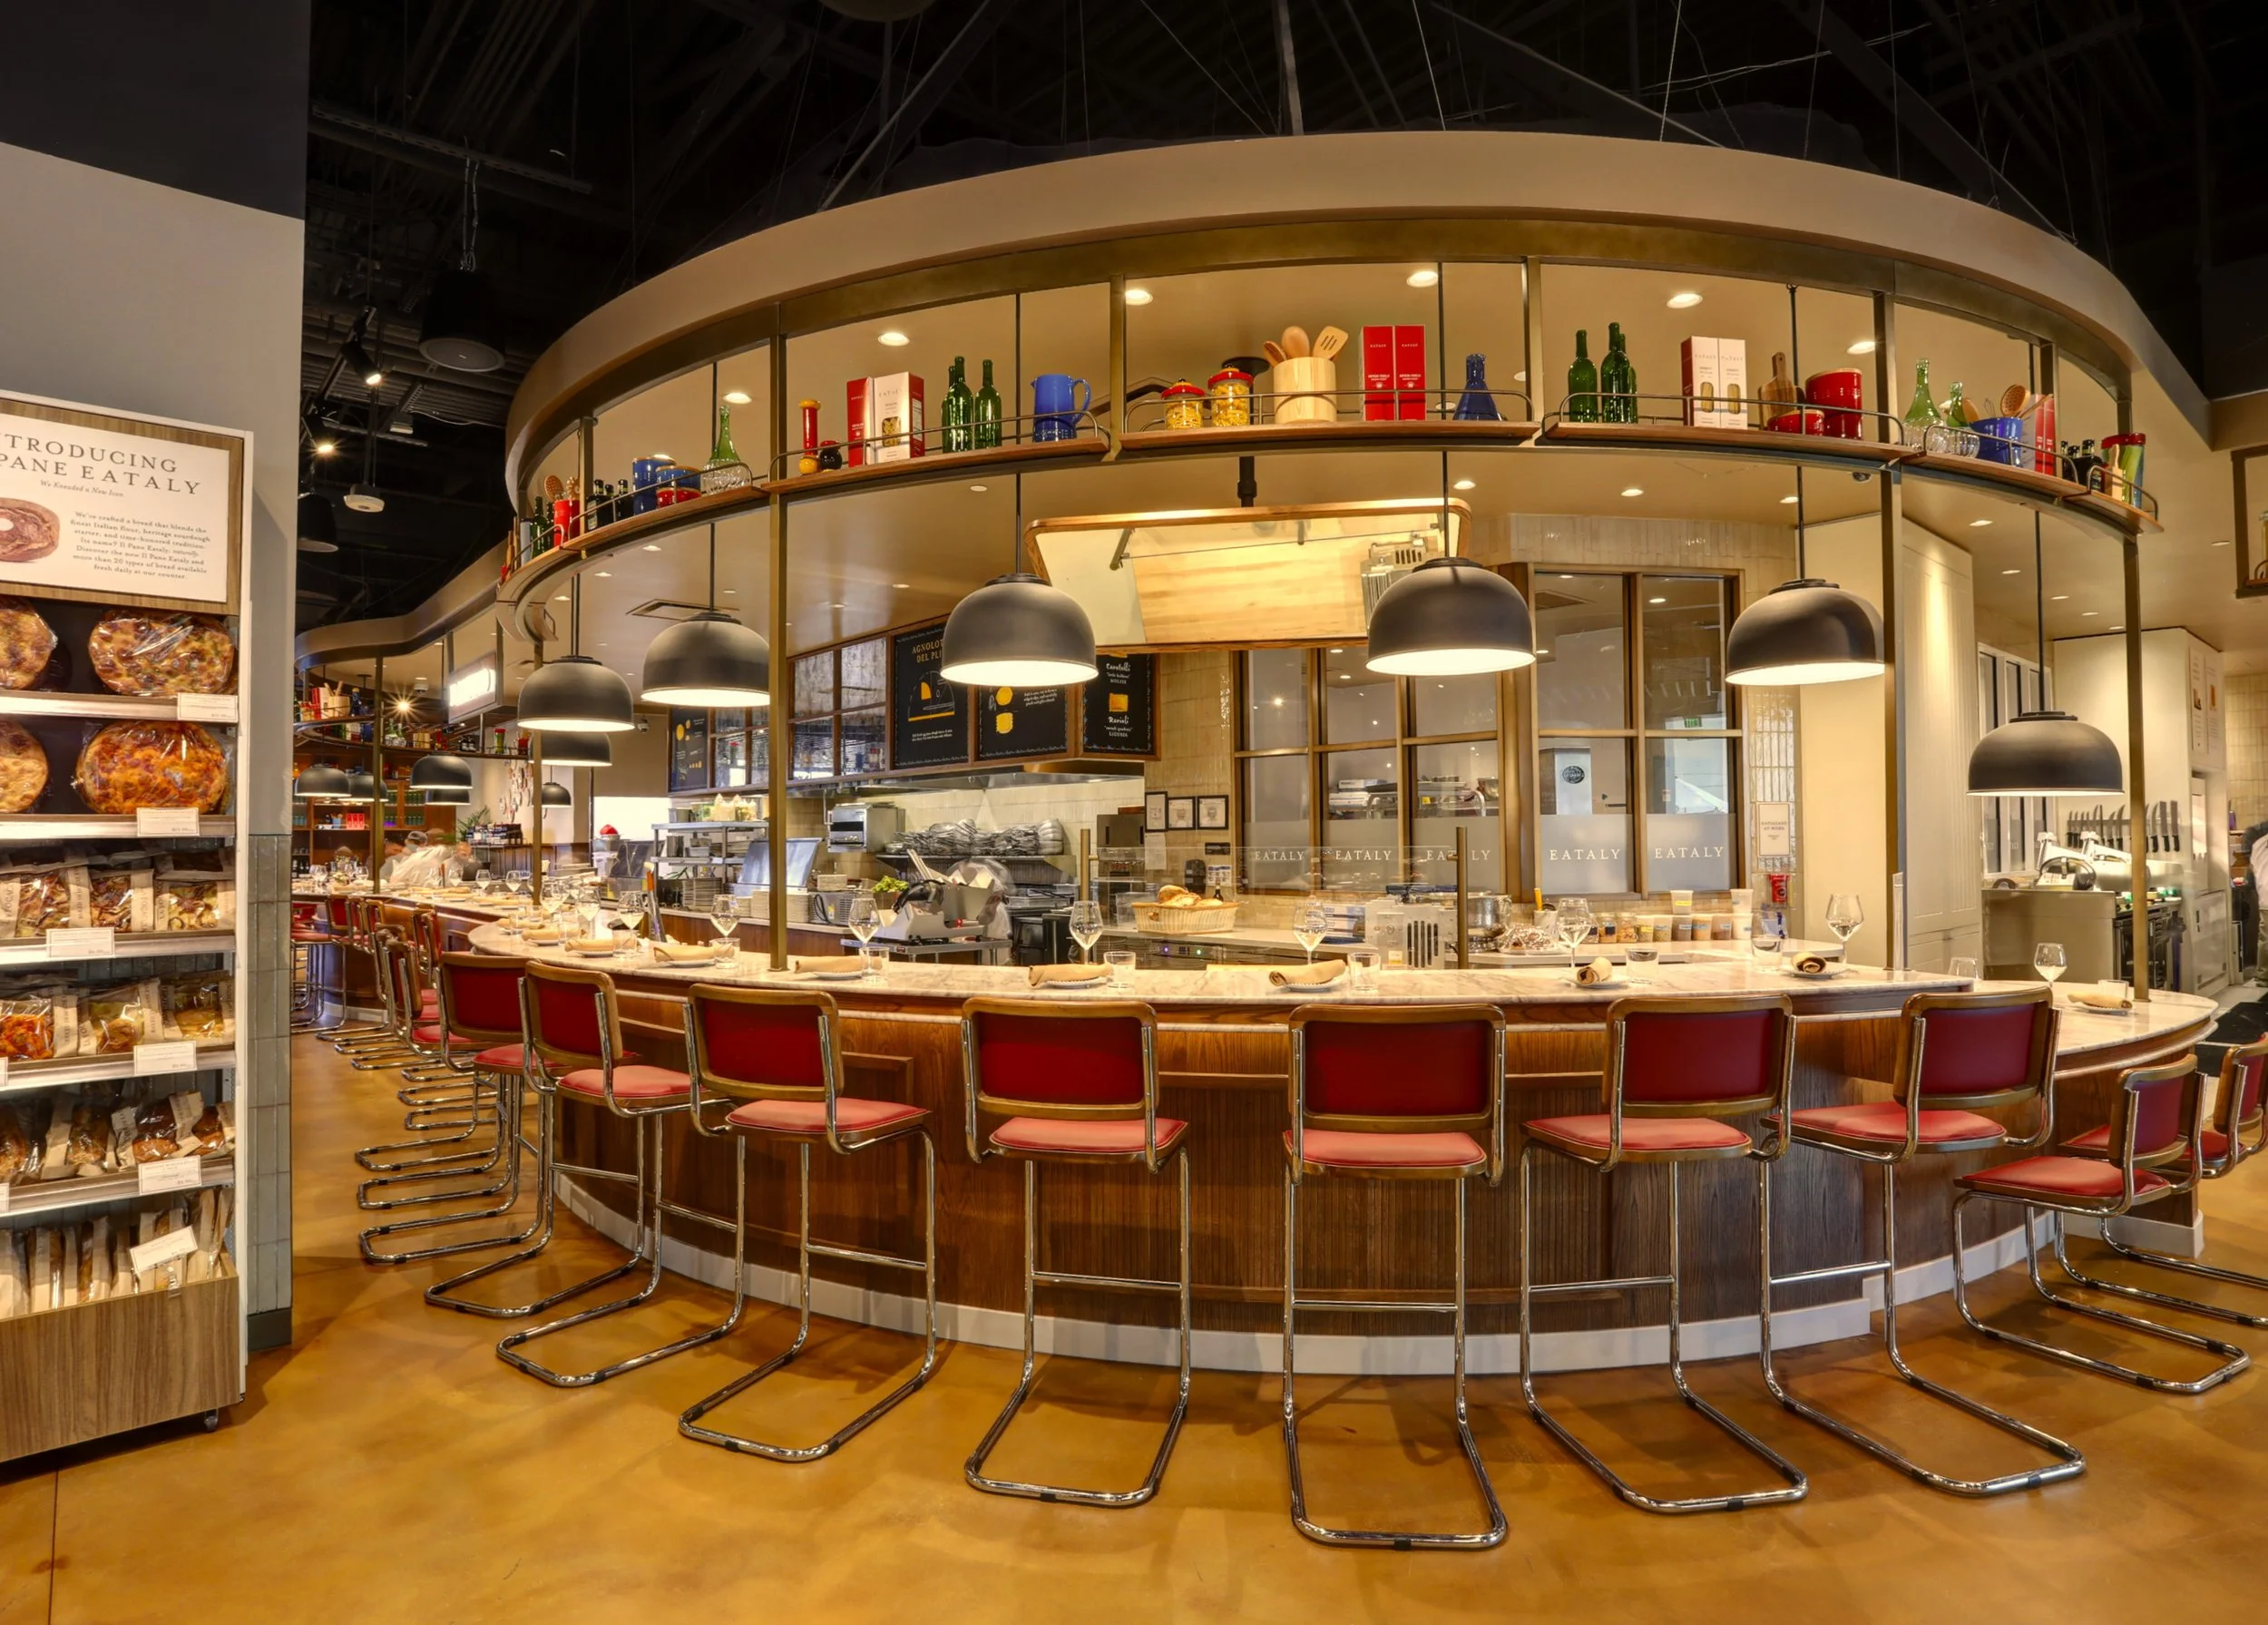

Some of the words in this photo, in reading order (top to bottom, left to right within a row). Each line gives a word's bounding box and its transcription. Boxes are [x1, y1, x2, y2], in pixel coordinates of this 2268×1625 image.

[0, 433, 177, 473] TRODUCING
[82, 465, 200, 494] EATALY
[99, 514, 124, 524] crafted
[94, 523, 118, 531] Italian
[143, 528, 171, 537] heritage
[76, 545, 109, 553] Discover
[115, 566, 132, 574] daily
[178, 565, 207, 573] available
[912, 639, 943, 654] AGNOLOT
[917, 654, 929, 663] DEL
[1256, 851, 1305, 860] EATALY
[1335, 850, 1392, 860] EATALY
[1427, 850, 1491, 860] EALY
[1549, 849, 1620, 861] EATALY
[1655, 847, 1724, 858] EATALY
